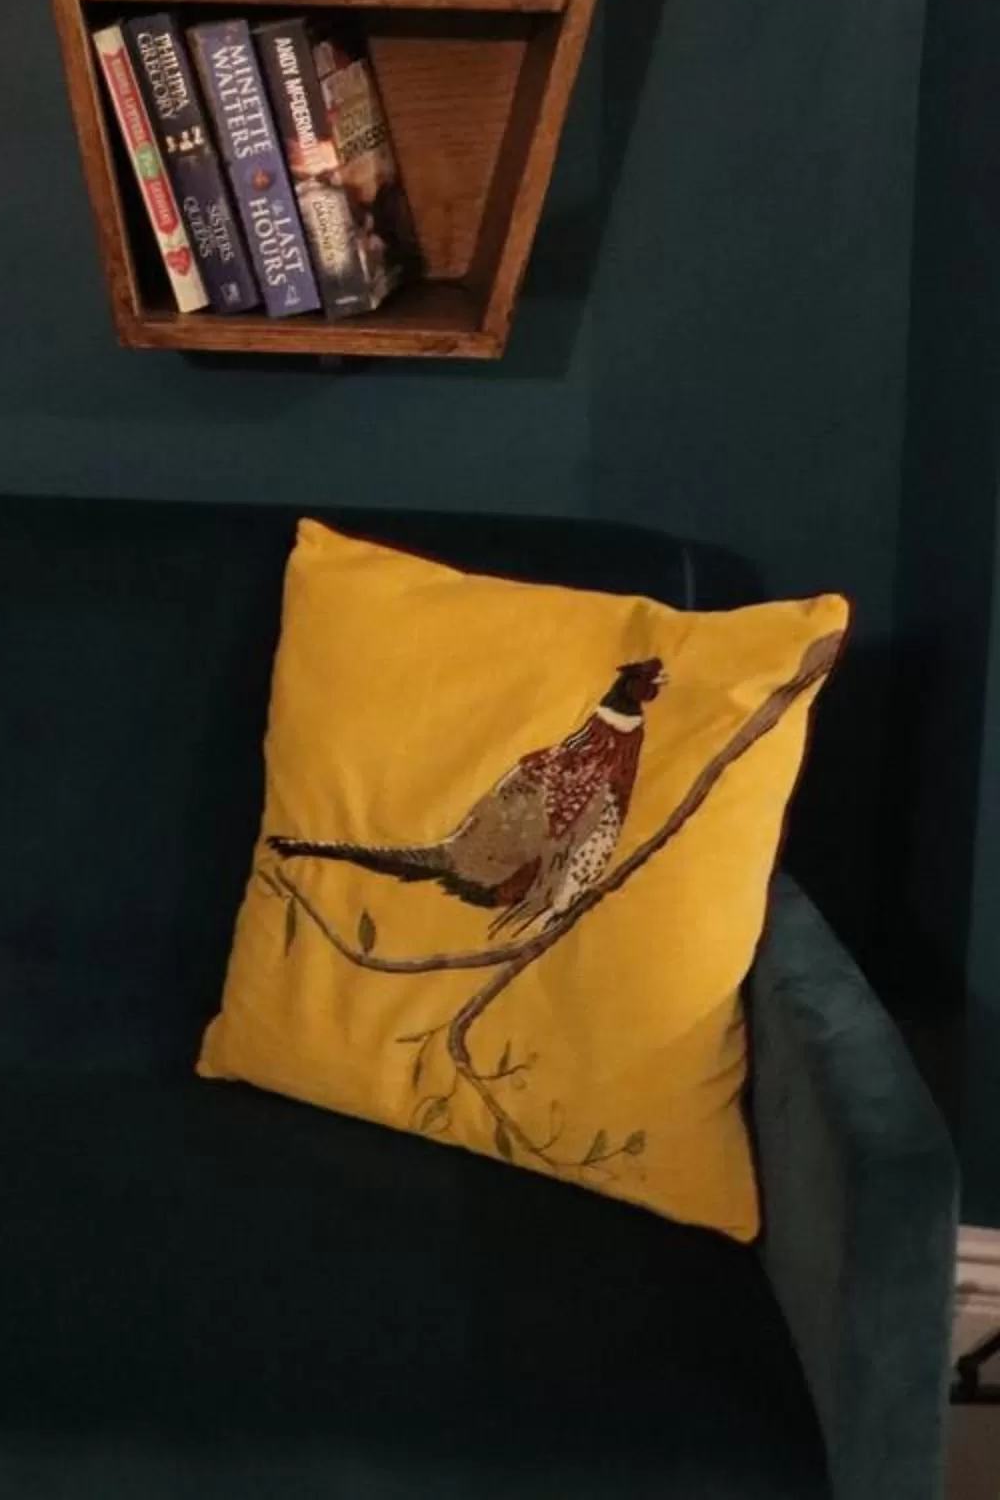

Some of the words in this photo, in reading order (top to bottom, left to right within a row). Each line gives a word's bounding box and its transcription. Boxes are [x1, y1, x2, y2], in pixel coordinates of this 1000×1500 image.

[136, 31, 176, 122] GREGORY
[157, 32, 191, 110] PHILIPPA
[226, 41, 271, 152] MINETTE
[271, 34, 300, 77] ANDY
[207, 48, 253, 159] WALTERS
[246, 197, 286, 287] HOURS
[275, 216, 304, 276] LAST
